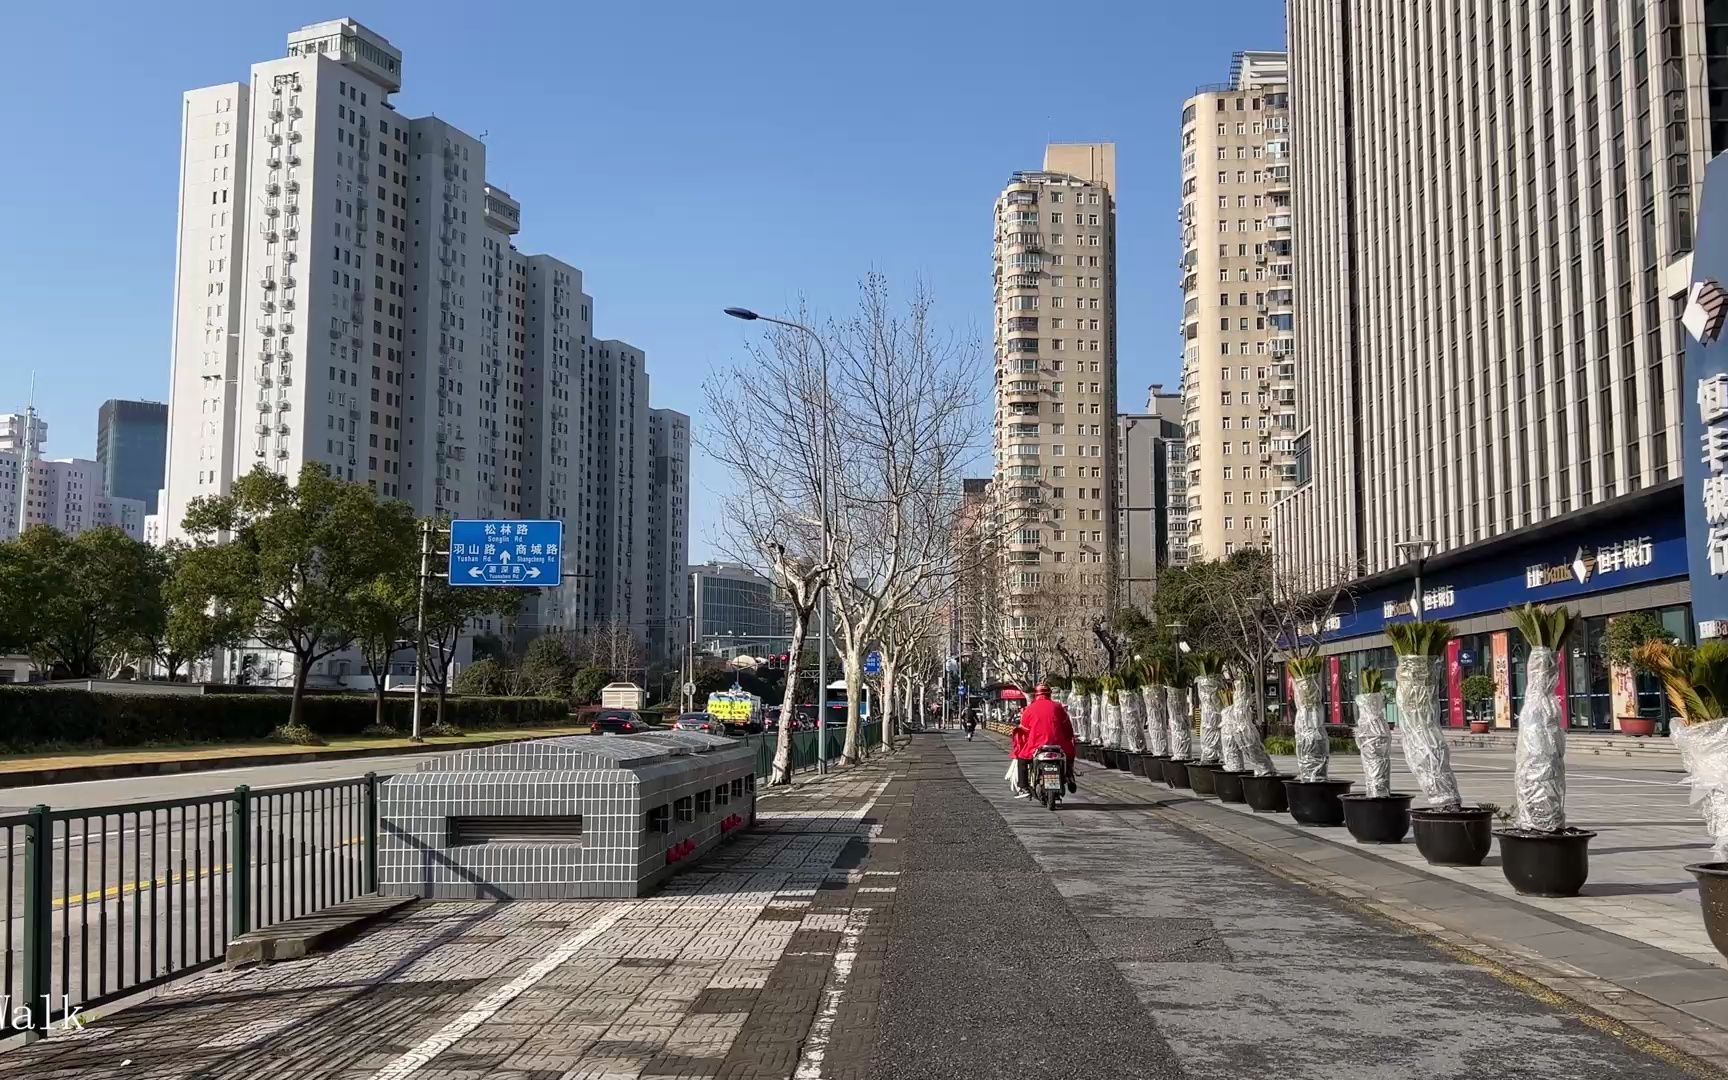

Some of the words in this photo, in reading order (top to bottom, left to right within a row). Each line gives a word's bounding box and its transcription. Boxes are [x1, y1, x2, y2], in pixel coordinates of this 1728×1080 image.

[484, 523, 528, 535] 松林路
[487, 535, 510, 544] Songlin
[453, 543, 496, 555] 羽山路
[516, 543, 558, 555] 商城路
